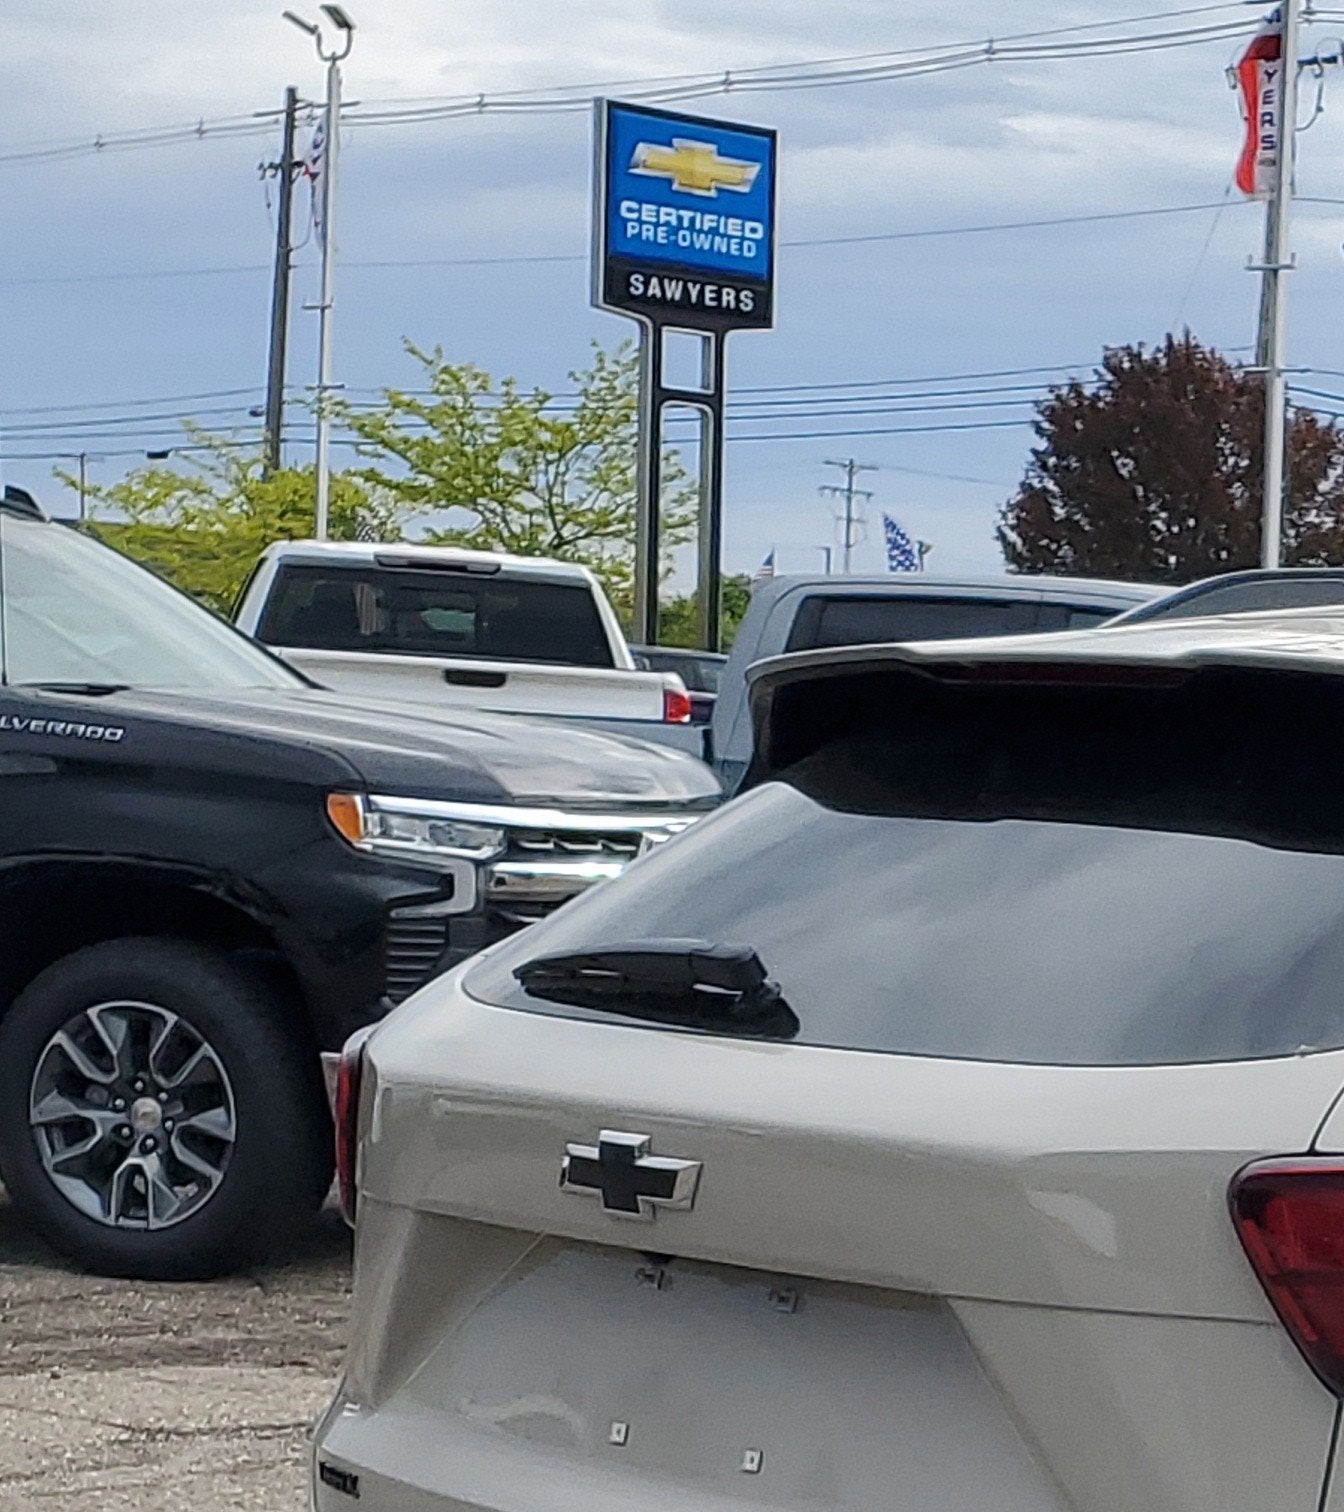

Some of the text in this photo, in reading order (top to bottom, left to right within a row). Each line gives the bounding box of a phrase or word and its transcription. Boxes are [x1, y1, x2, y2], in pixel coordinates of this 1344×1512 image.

[1260, 58, 1278, 151] YERS
[619, 200, 764, 239] CERTIFIED
[626, 222, 757, 258] PRE-OWNED
[628, 273, 755, 312] SAWYERS
